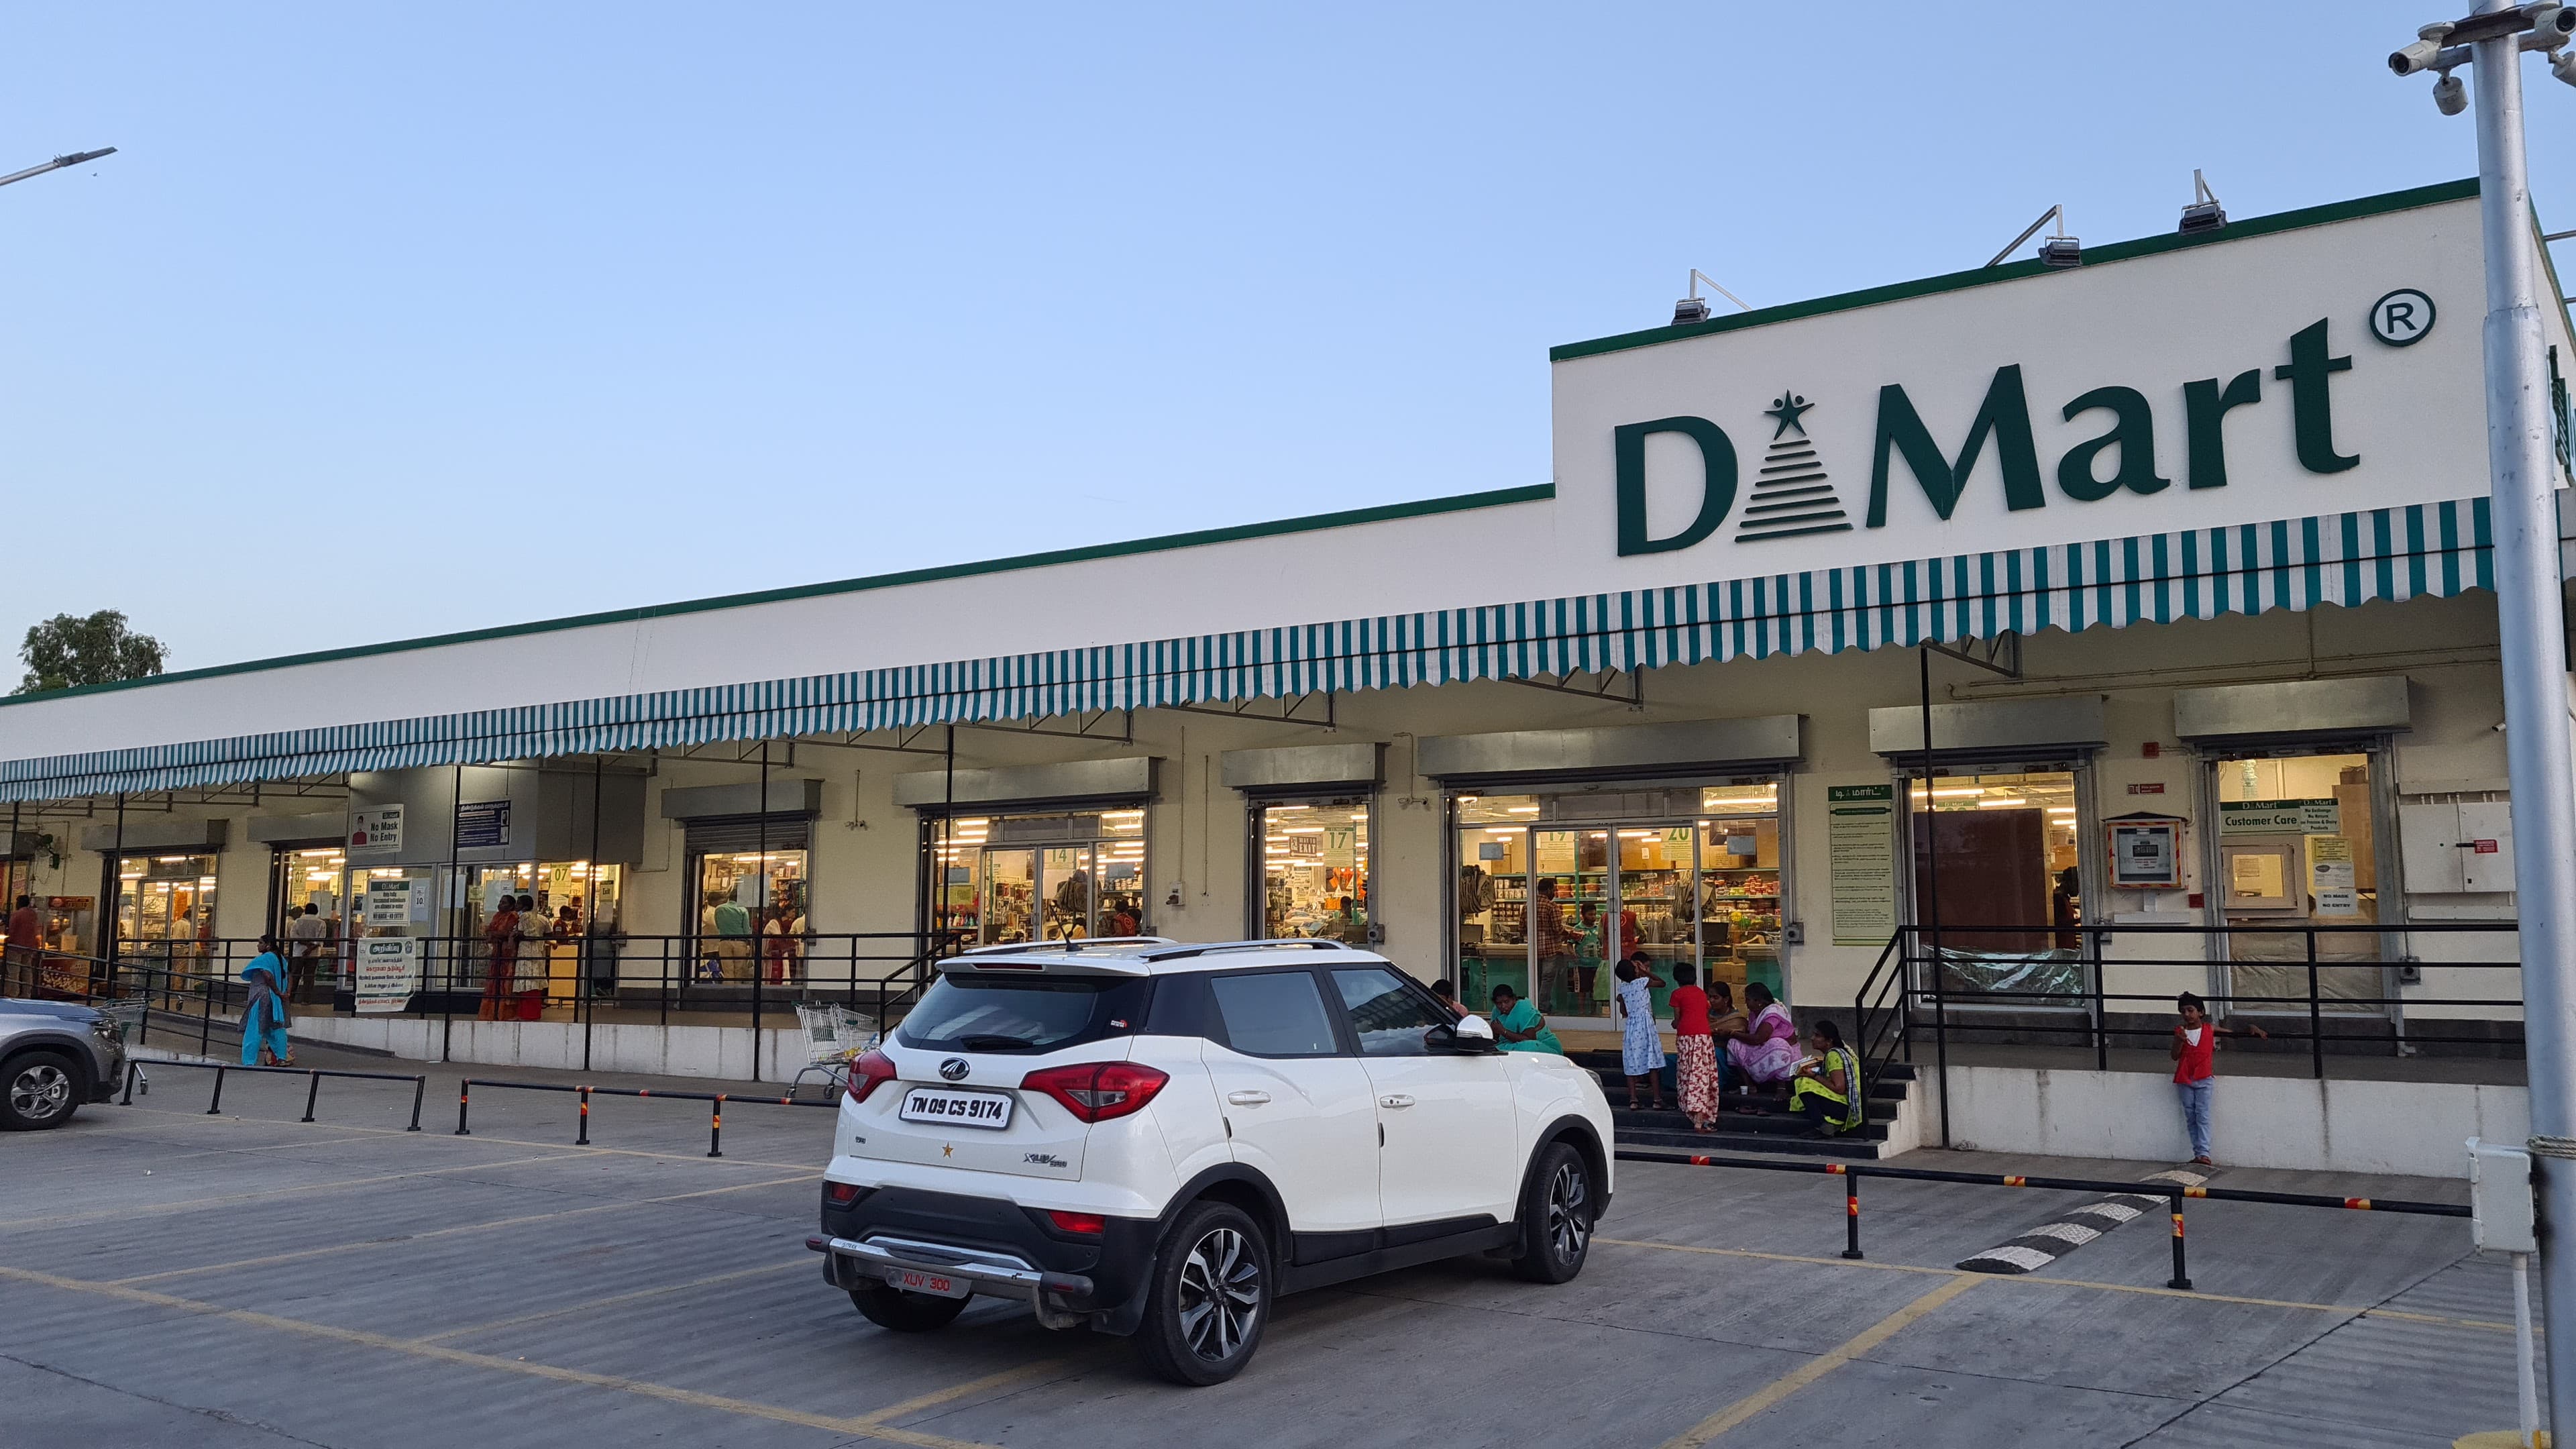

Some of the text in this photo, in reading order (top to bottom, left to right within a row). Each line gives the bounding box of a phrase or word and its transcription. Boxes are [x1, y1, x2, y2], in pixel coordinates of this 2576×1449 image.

[1866, 316, 2361, 527] Mart
[1852, 787, 1881, 796] மார்ட்
[370, 821, 398, 831] No Mask
[2225, 814, 2298, 826] Customer Care
[370, 832, 397, 843] No Entry
[1330, 832, 1347, 849] 17
[1668, 828, 1690, 841] 20
[1299, 844, 1316, 853] EXIT
[1053, 849, 1067, 862] 14
[555, 868, 568, 881] 07
[911, 1097, 1004, 1120] TN 09 CS 9174
[904, 1273, 950, 1292] XUV 300
